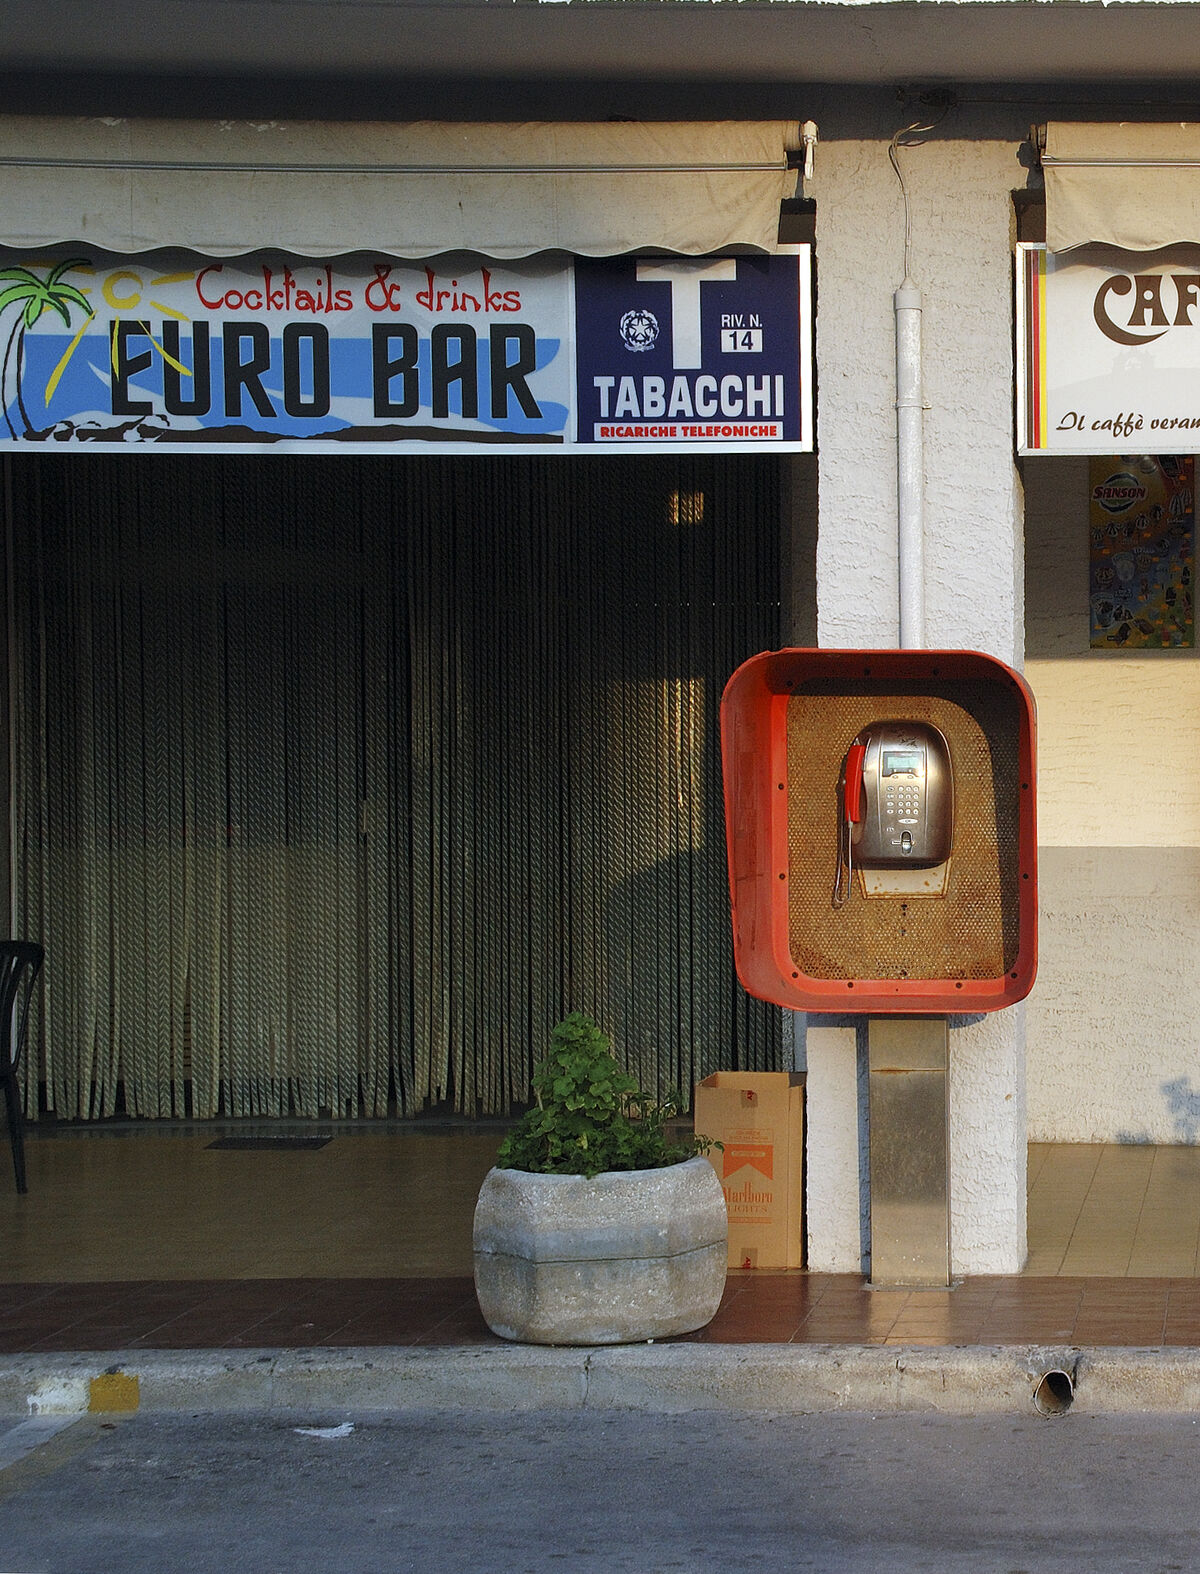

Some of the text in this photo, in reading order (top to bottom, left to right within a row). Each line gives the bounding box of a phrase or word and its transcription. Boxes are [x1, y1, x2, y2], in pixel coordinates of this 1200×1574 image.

[195, 264, 522, 314] Cocktails & drinks
[636, 258, 737, 370] T
[721, 314, 763, 328] RIV. N.
[728, 331, 754, 351] 14
[110, 320, 543, 419] EURO BAR
[593, 374, 785, 418] TABACCHI
[600, 424, 778, 438] RICARICHE TELEFONICHE
[1056, 411, 1085, 431] Il
[1091, 413, 1144, 436] caffè
[1092, 486, 1147, 500] SANSON
